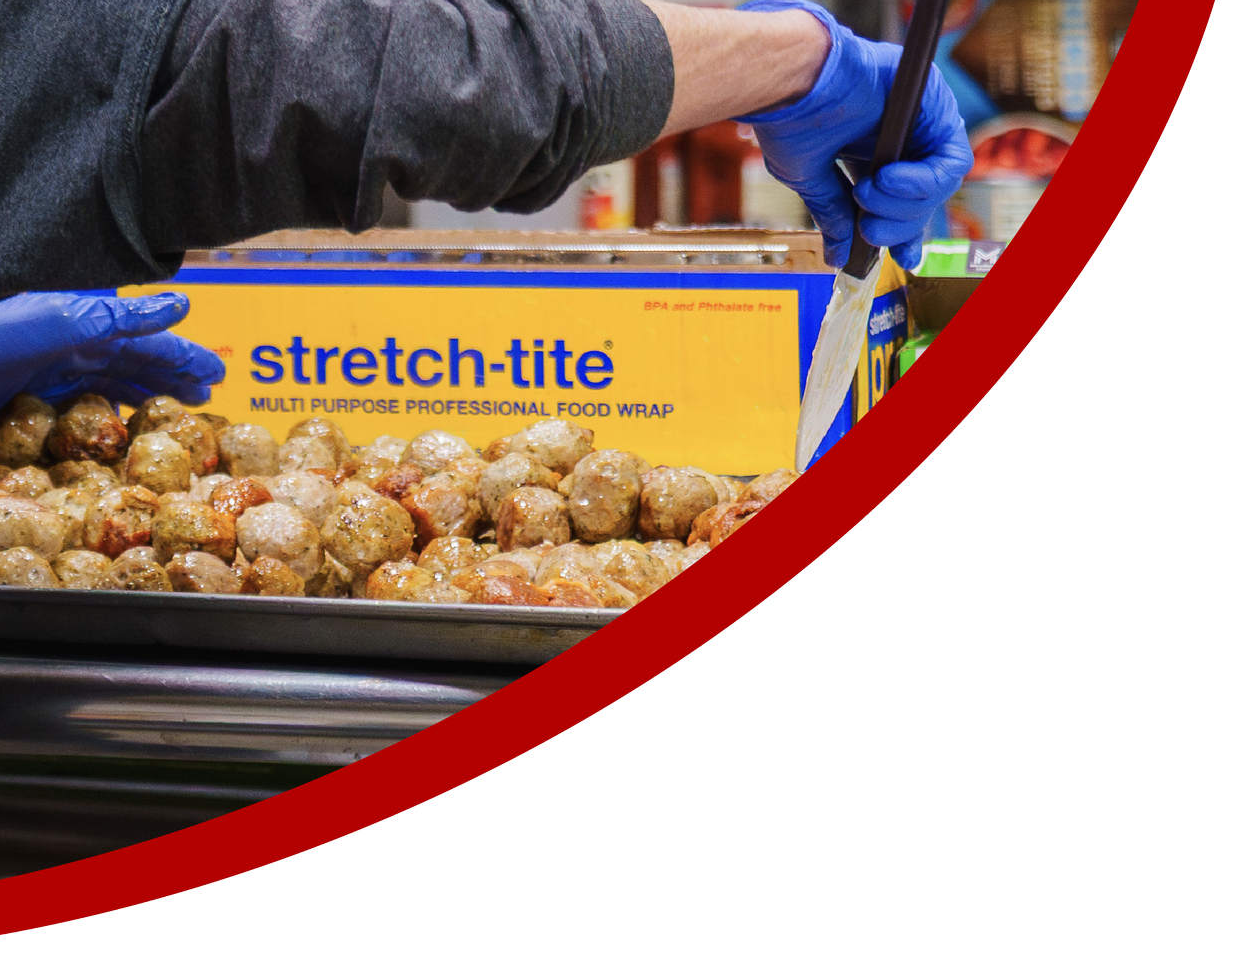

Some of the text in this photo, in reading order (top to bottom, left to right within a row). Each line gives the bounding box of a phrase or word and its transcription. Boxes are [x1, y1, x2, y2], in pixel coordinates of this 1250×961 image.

[644, 301, 782, 313] BPA and Phthalate free
[250, 336, 614, 390] stretch-tite
[250, 397, 675, 419] MULTI PURPOSE PROFESSIONAL FOOD WRAP
